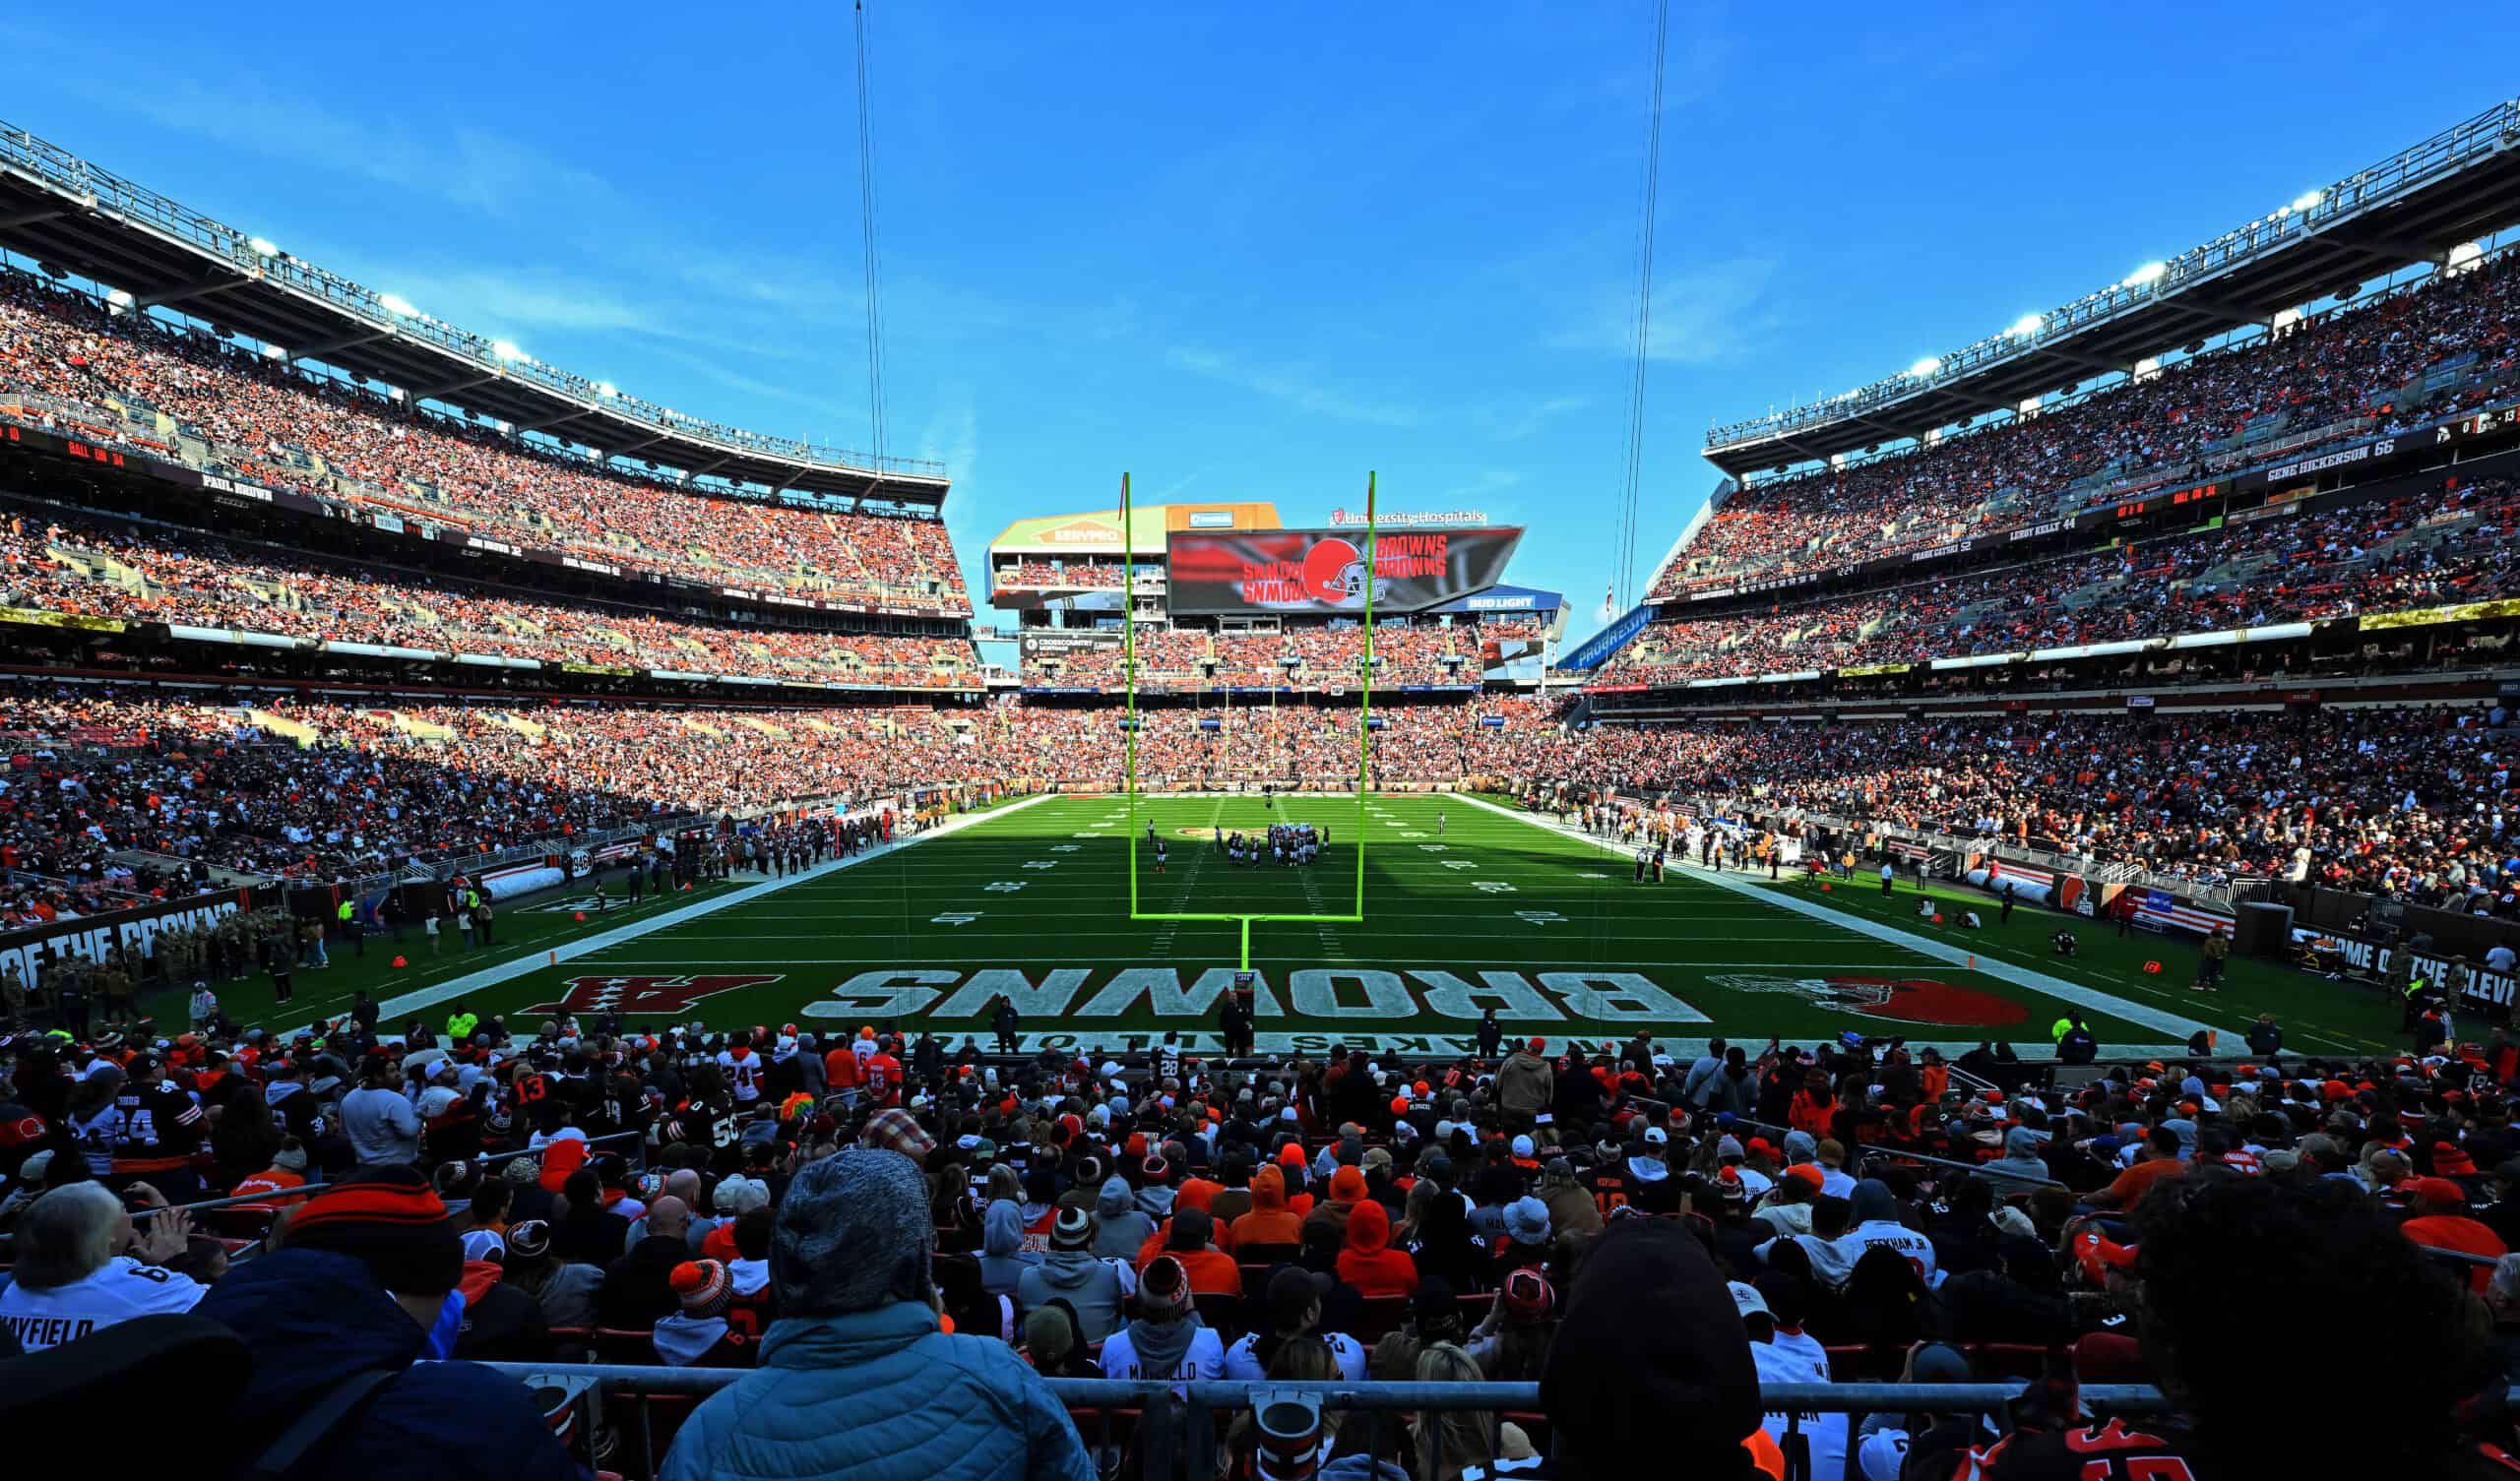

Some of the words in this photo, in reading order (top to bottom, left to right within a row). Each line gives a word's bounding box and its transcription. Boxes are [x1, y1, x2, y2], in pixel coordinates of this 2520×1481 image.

[2463, 421, 2470, 433] 0
[2504, 409, 2516, 422] 13
[68, 440, 90, 458] BALL
[2267, 466, 2298, 482] GENE
[2299, 446, 2368, 475] HICKERSON
[2374, 438, 2395, 457] 66
[2173, 491, 2189, 504] BALL
[1345, 510, 1419, 526] Uniersity
[1418, 508, 1484, 525] Hospitals
[2009, 526, 2035, 541] LEROY
[2035, 522, 2061, 537] KELLY
[2063, 517, 2076, 529] 44
[1055, 529, 1118, 542] SERVPRO
[1375, 534, 1448, 559] BROWNS
[1374, 558, 1448, 580] BROWNS
[1470, 597, 1495, 608] BUD
[1495, 597, 1533, 608] LIGHT
[0, 941, 45, 989] OF
[46, 924, 115, 967] THE
[2410, 956, 2450, 990] THE
[799, 967, 1717, 1023] BROWNS
[1161, 1059, 1179, 1077] 28
[514, 1075, 548, 1103] 13
